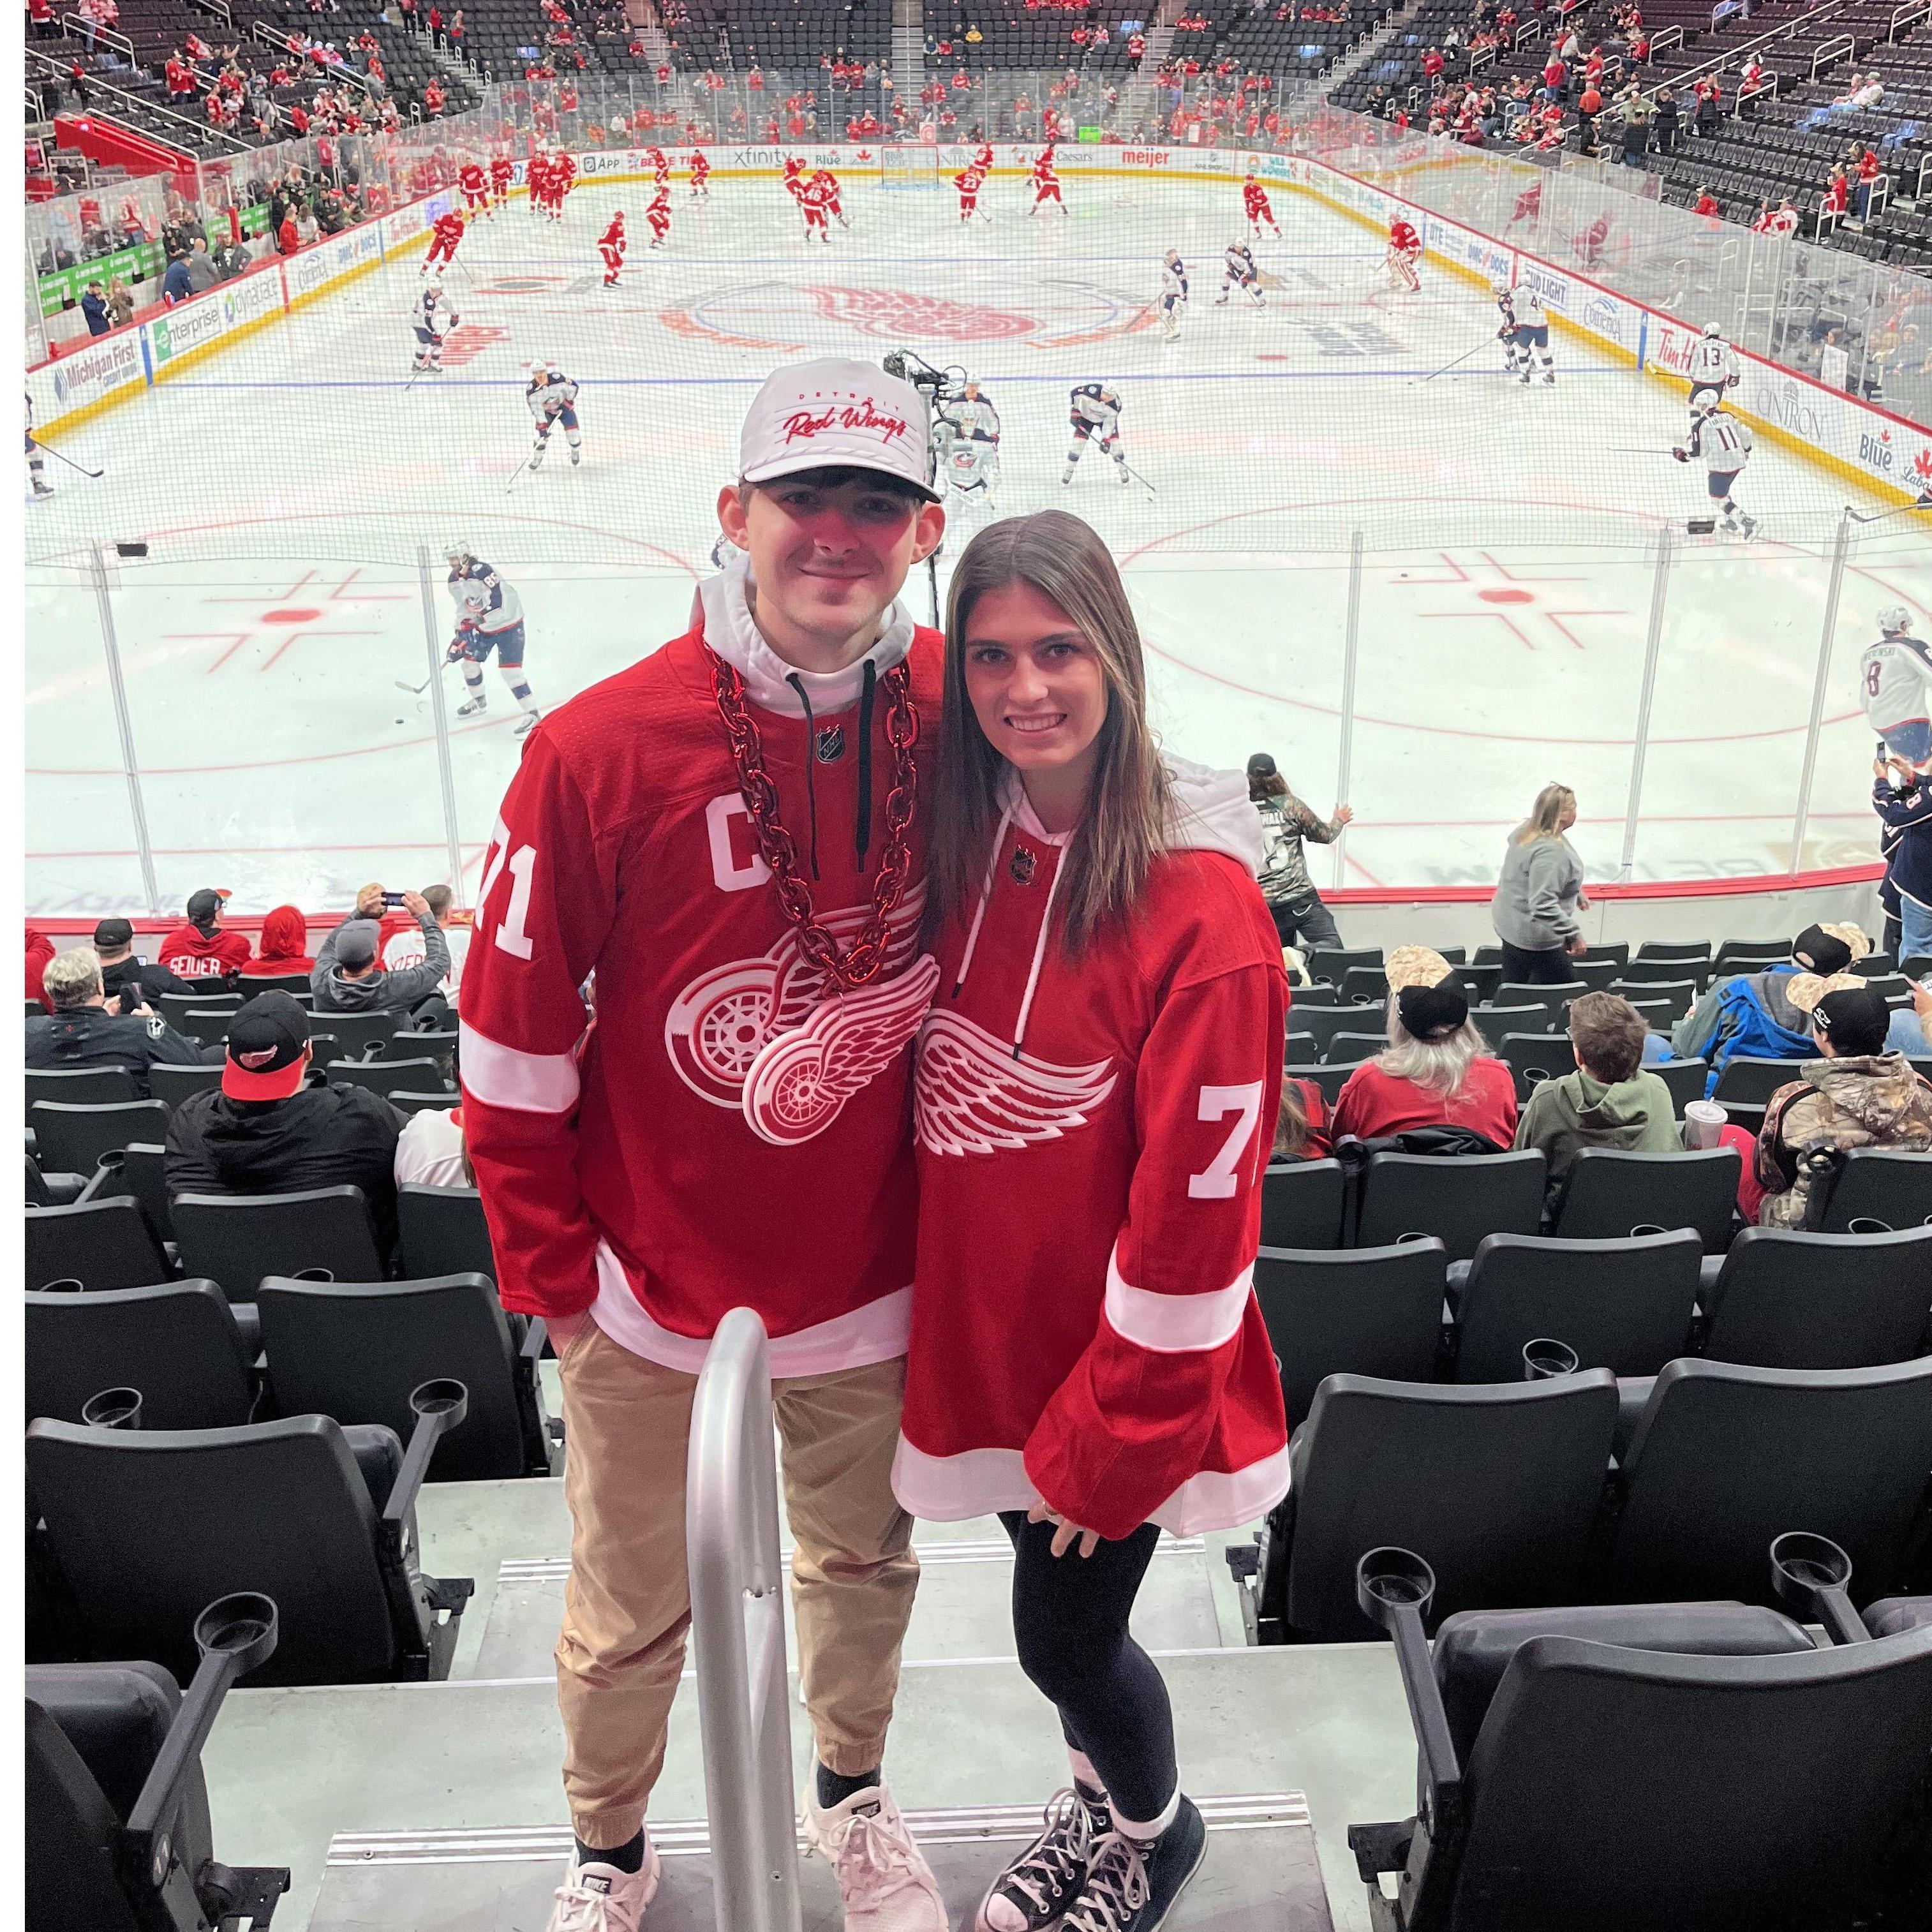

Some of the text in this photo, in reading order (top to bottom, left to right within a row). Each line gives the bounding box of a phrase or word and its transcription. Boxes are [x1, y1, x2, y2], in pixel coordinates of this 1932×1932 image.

[735, 147, 794, 167] xfinity
[815, 154, 842, 165] Blue
[1121, 145, 1170, 167] meijer
[805, 188, 823, 202] 46
[1526, 269, 1566, 303] UD LIGHT
[156, 308, 218, 350] enterprise
[66, 341, 135, 390] Michigan First
[1702, 347, 1721, 367] 13
[799, 391, 900, 412] DETROIT
[1757, 387, 1824, 442] CINTRON
[783, 401, 907, 444] Red Wings
[1716, 425, 1738, 452] 11
[1859, 433, 1892, 472] Blue
[1867, 660, 1882, 697] 8
[705, 792, 775, 893] C
[473, 812, 537, 961] 71
[1187, 1080, 1264, 1200] 7
